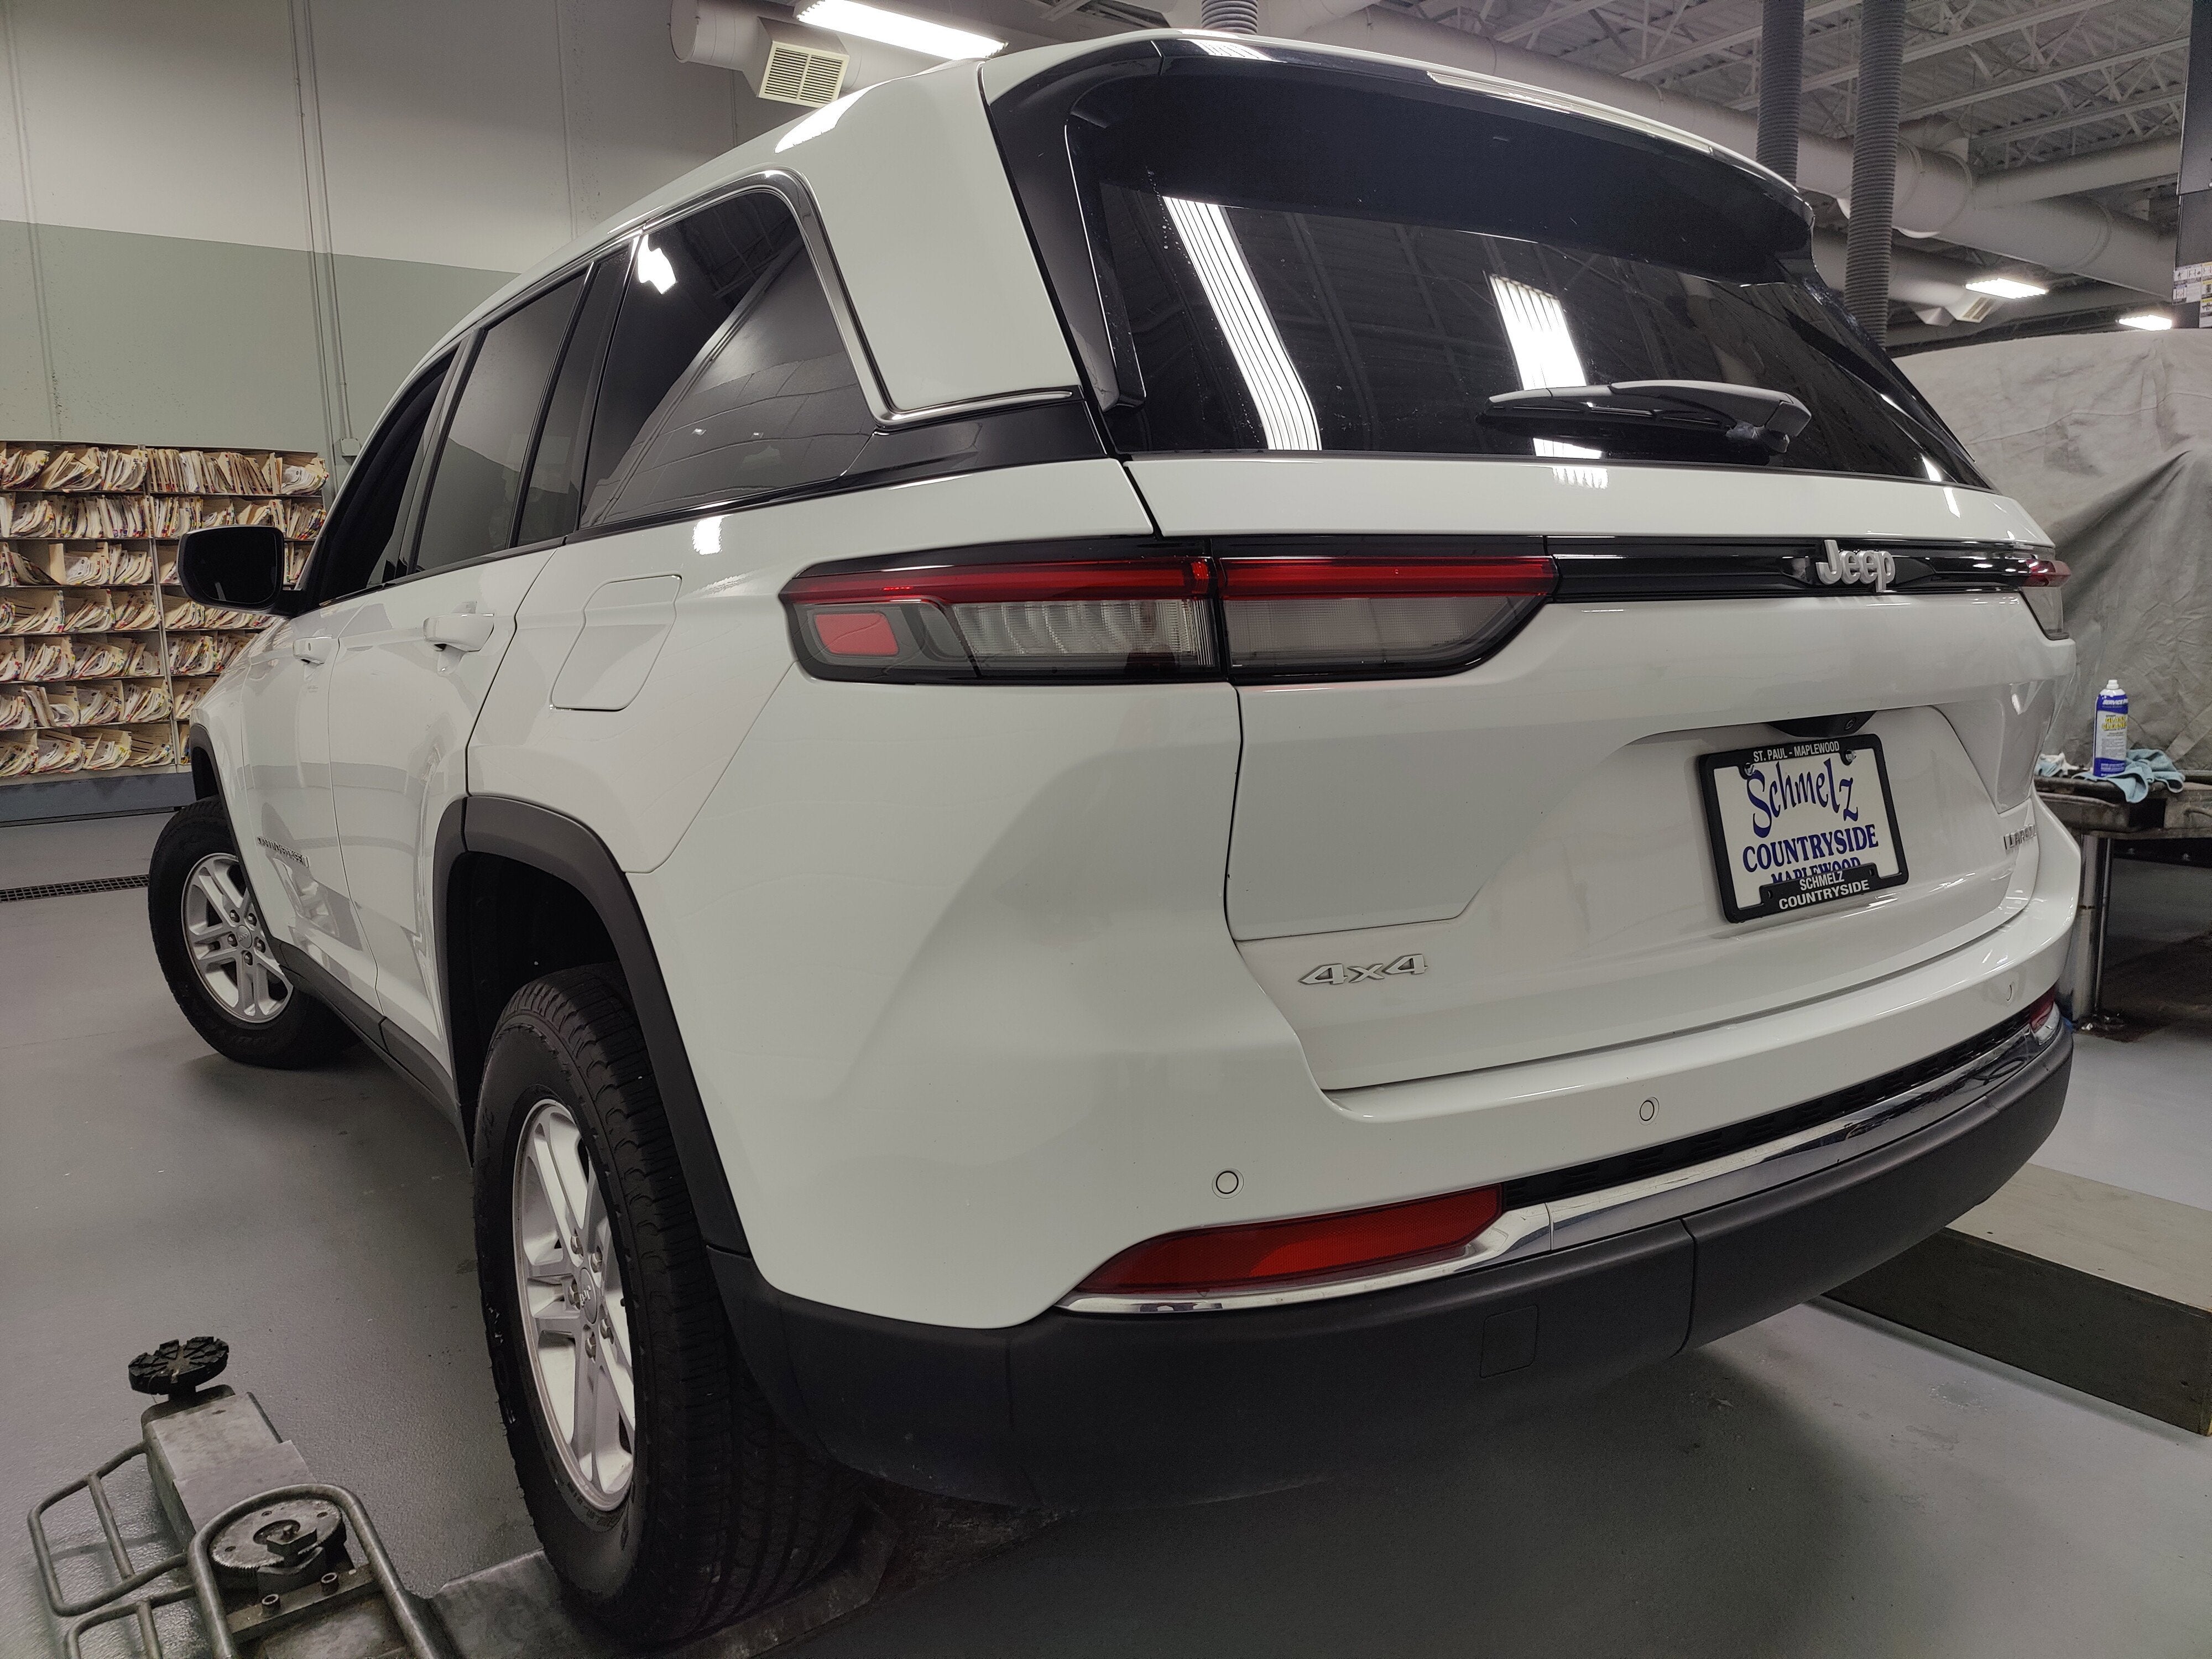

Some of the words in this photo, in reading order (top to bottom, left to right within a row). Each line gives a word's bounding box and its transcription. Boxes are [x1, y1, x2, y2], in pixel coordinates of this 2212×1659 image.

[1816, 540, 1895, 593] Jeep
[2101, 721, 2126, 730] CLEANE
[1753, 750, 1766, 763] ST.
[1767, 748, 1788, 760] PAUL
[1793, 741, 1840, 757] MAPLEWOOD
[1746, 758, 1858, 838] Schmelz
[1743, 824, 1879, 873] COUNTRYSIDE
[1778, 879, 1870, 910] COUNTRYSIDE
[1799, 871, 1845, 891] SCHMELZ
[1298, 953, 1428, 985] 4x4
